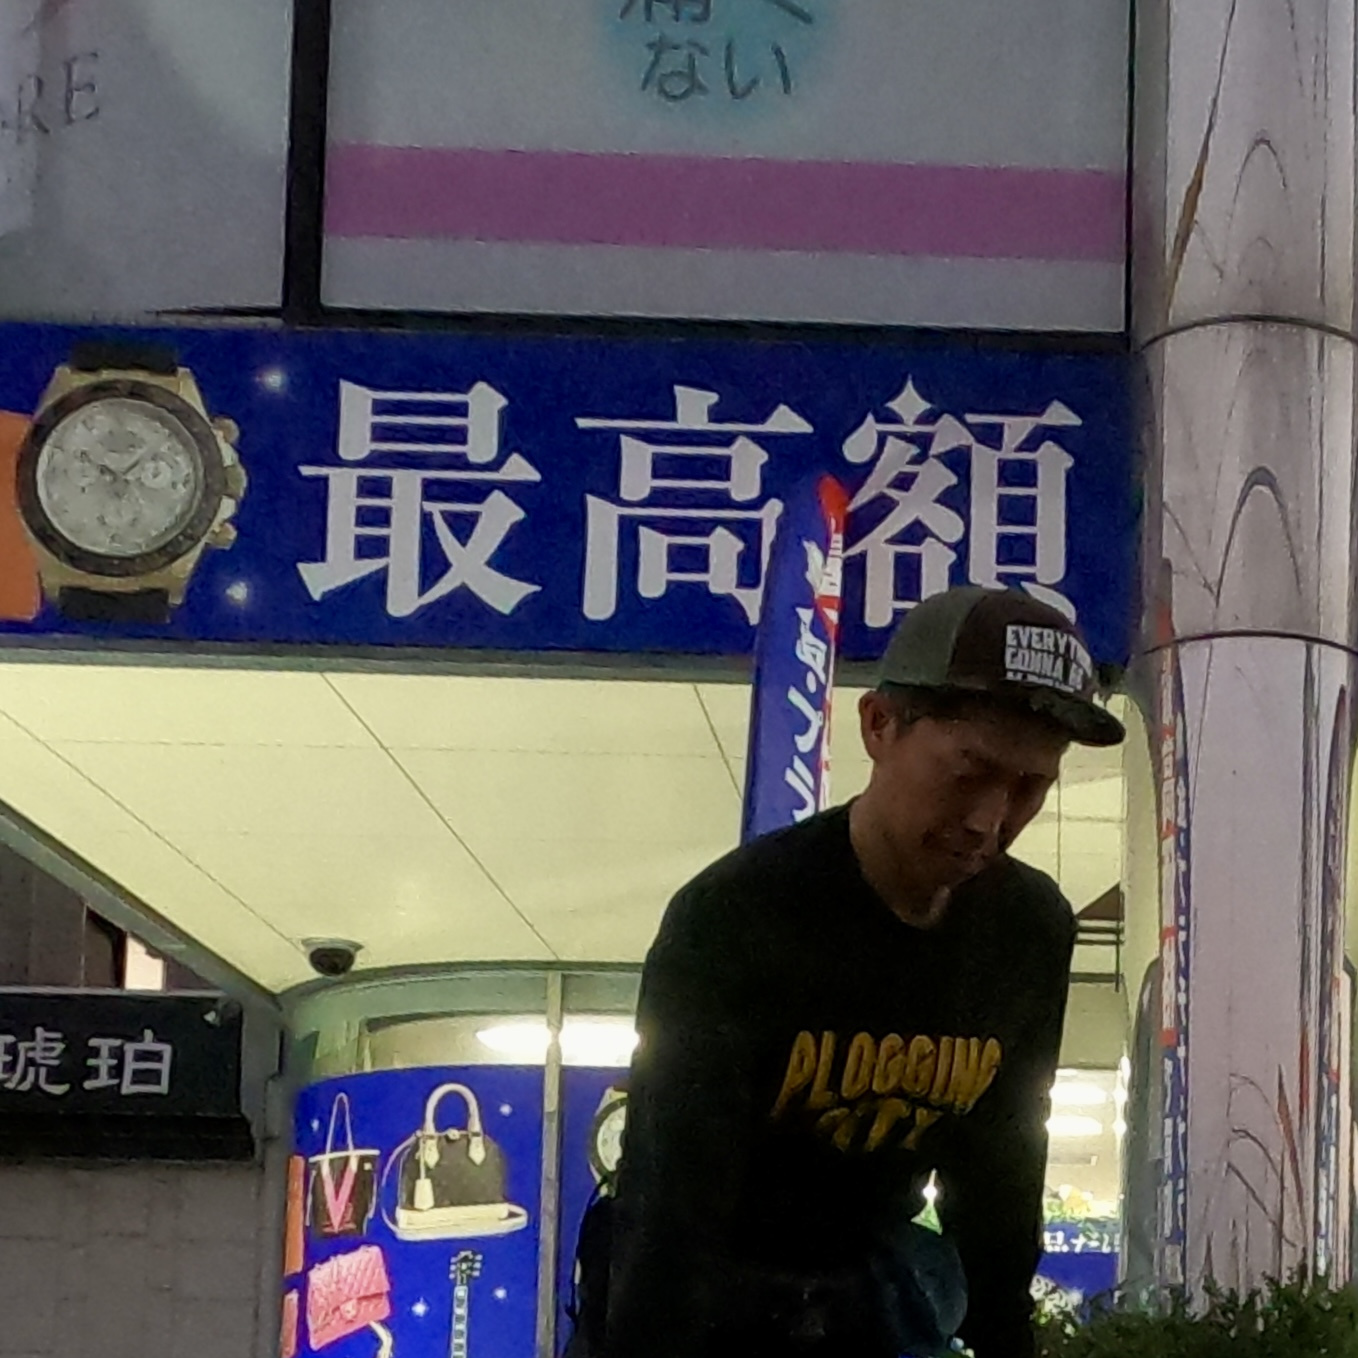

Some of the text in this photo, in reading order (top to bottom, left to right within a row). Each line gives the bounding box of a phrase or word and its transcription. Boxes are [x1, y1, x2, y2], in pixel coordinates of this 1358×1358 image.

[296, 374, 1083, 628] 最高額
[0, 1026, 172, 1096] 琥珀
